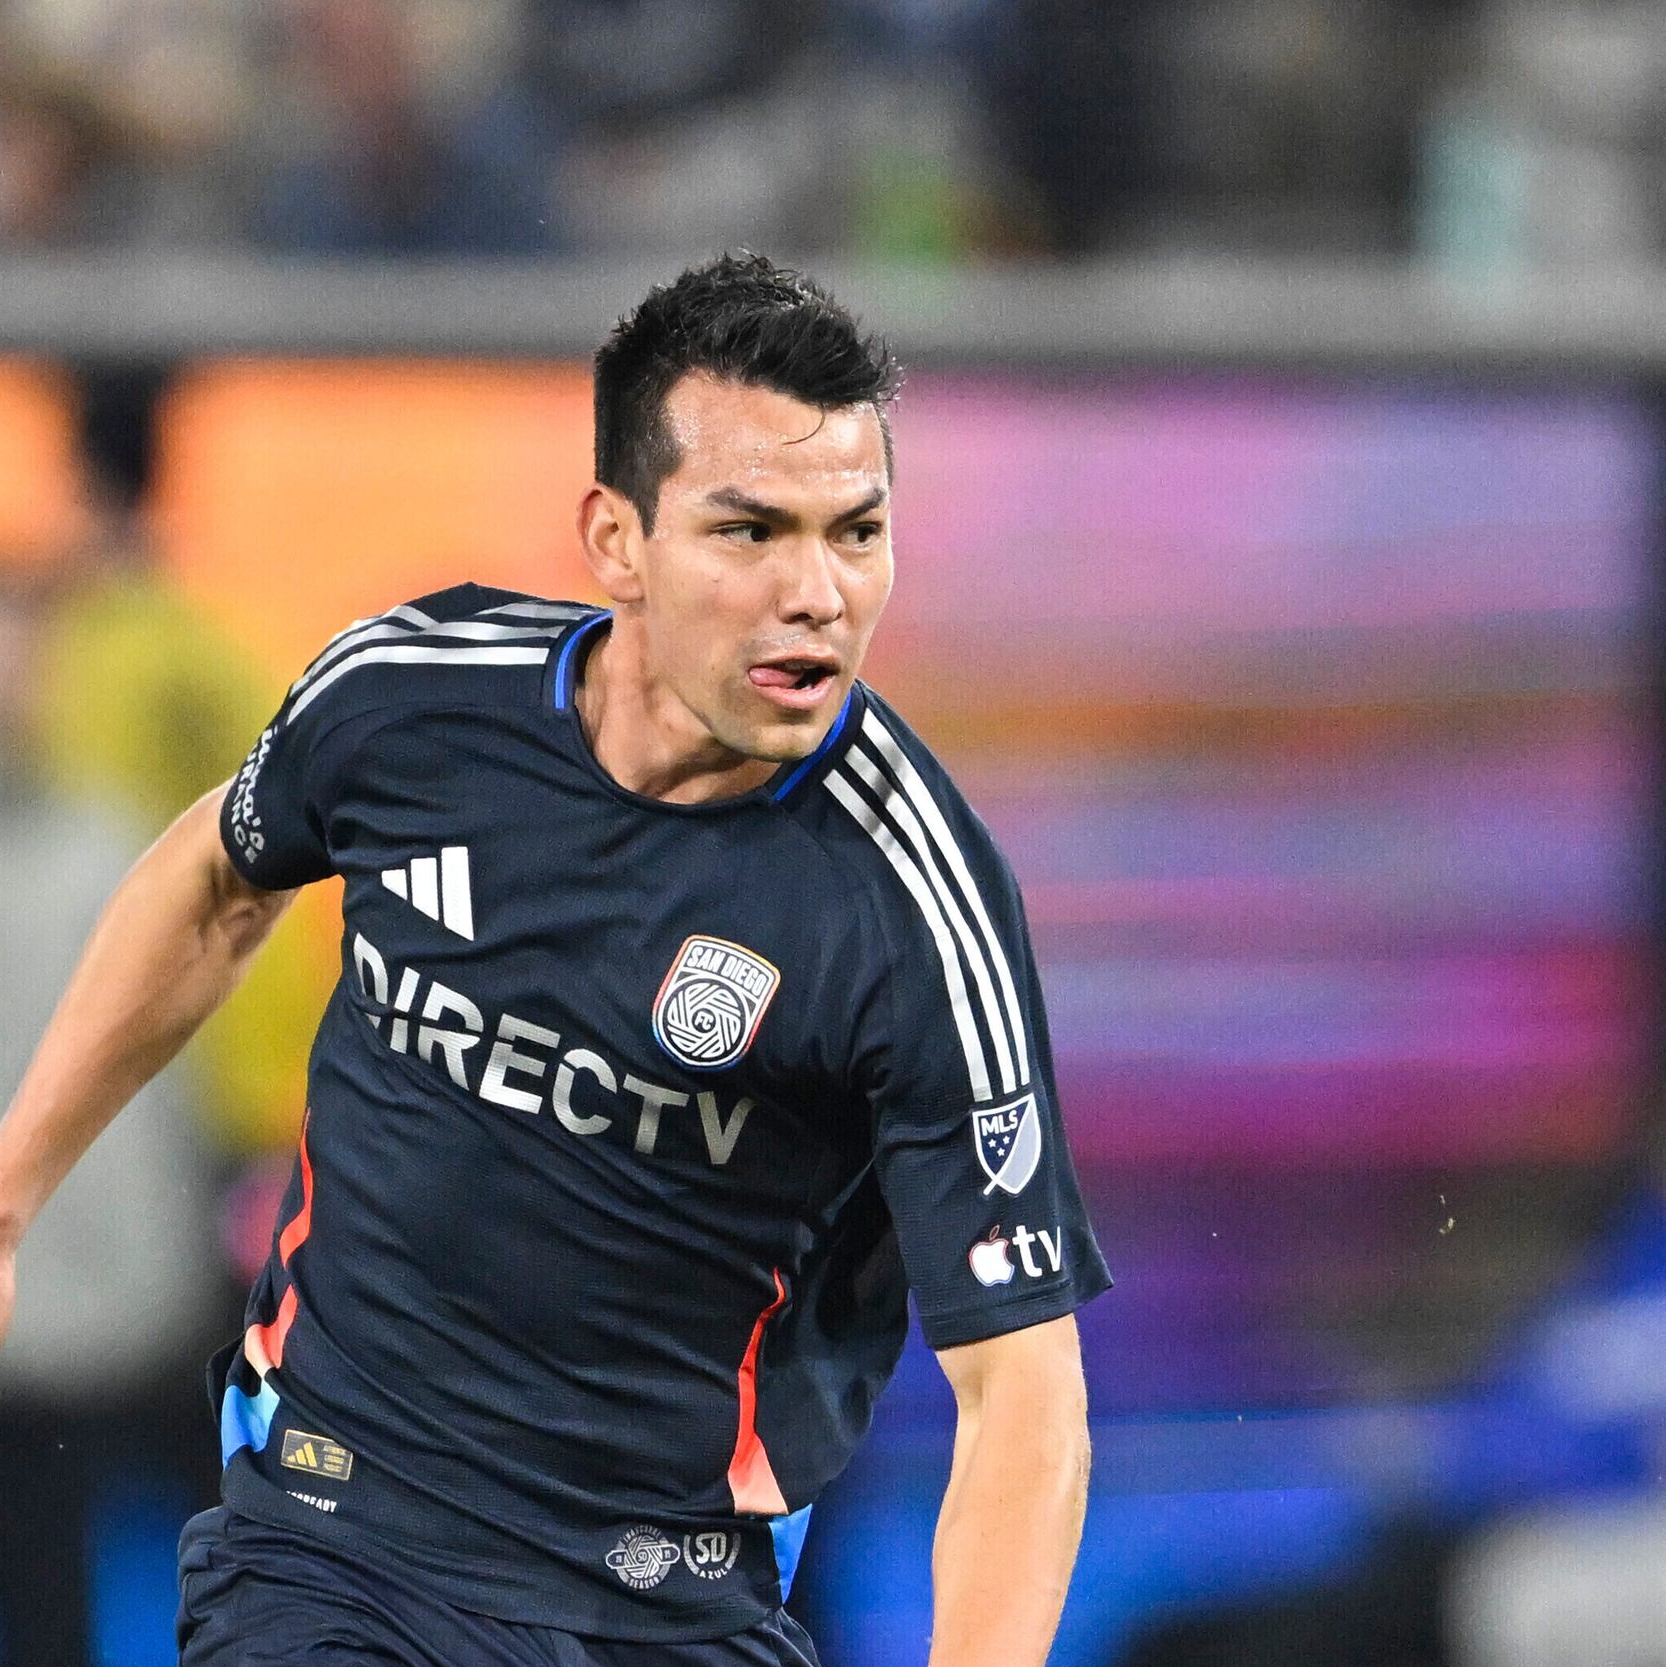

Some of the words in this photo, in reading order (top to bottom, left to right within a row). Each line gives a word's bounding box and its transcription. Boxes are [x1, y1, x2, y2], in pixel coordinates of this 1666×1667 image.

[686, 946, 726, 973] SAN
[721, 956, 768, 997] DIEGO
[694, 1010, 714, 1030] FC
[353, 932, 755, 1165] DIRECTV
[981, 1109, 1019, 1137] MLS
[1012, 1225, 1062, 1278] tv
[696, 1532, 727, 1564] SD
[699, 1568, 728, 1580] AZUL
